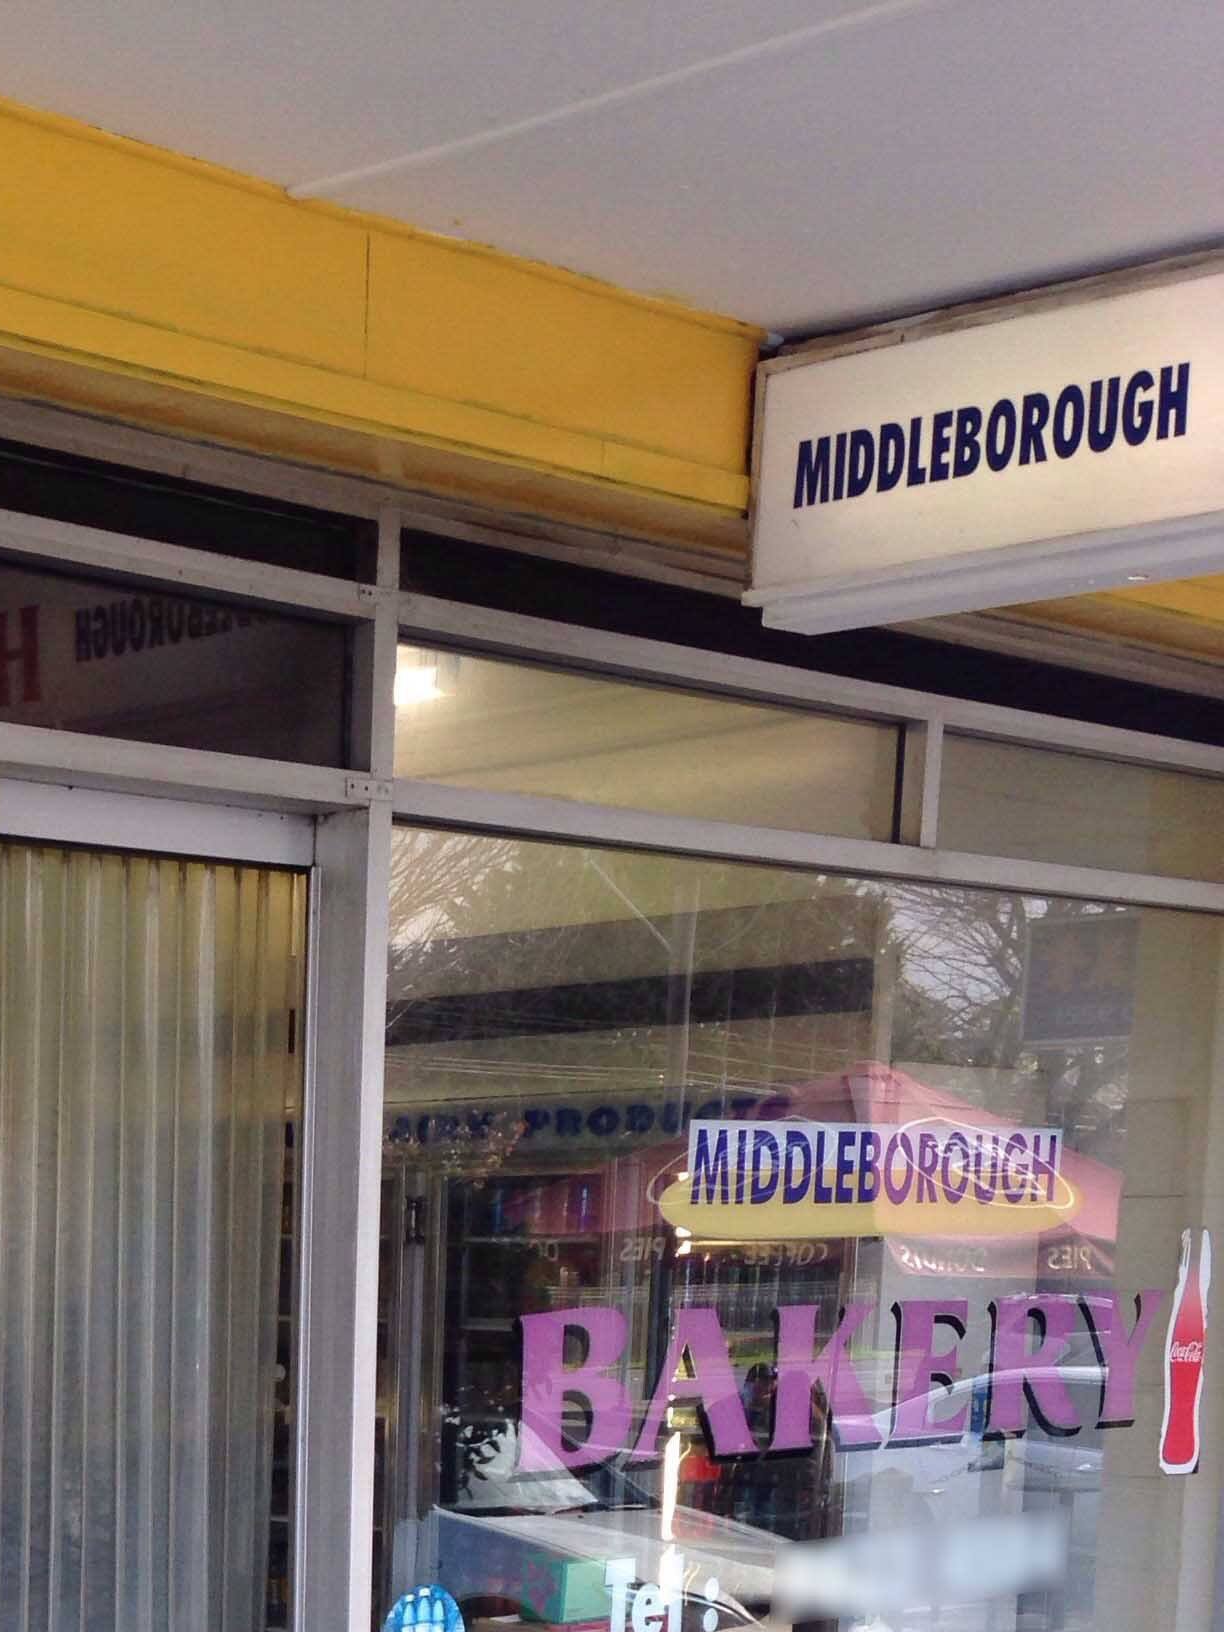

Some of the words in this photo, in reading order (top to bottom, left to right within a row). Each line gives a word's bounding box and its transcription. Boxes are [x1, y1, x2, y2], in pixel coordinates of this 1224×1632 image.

[793, 362, 1191, 509] MIDDLEBOROUGH
[690, 1128, 1060, 1206] MIDDLEBOROUGH
[516, 1288, 1165, 1478] BAKERY
